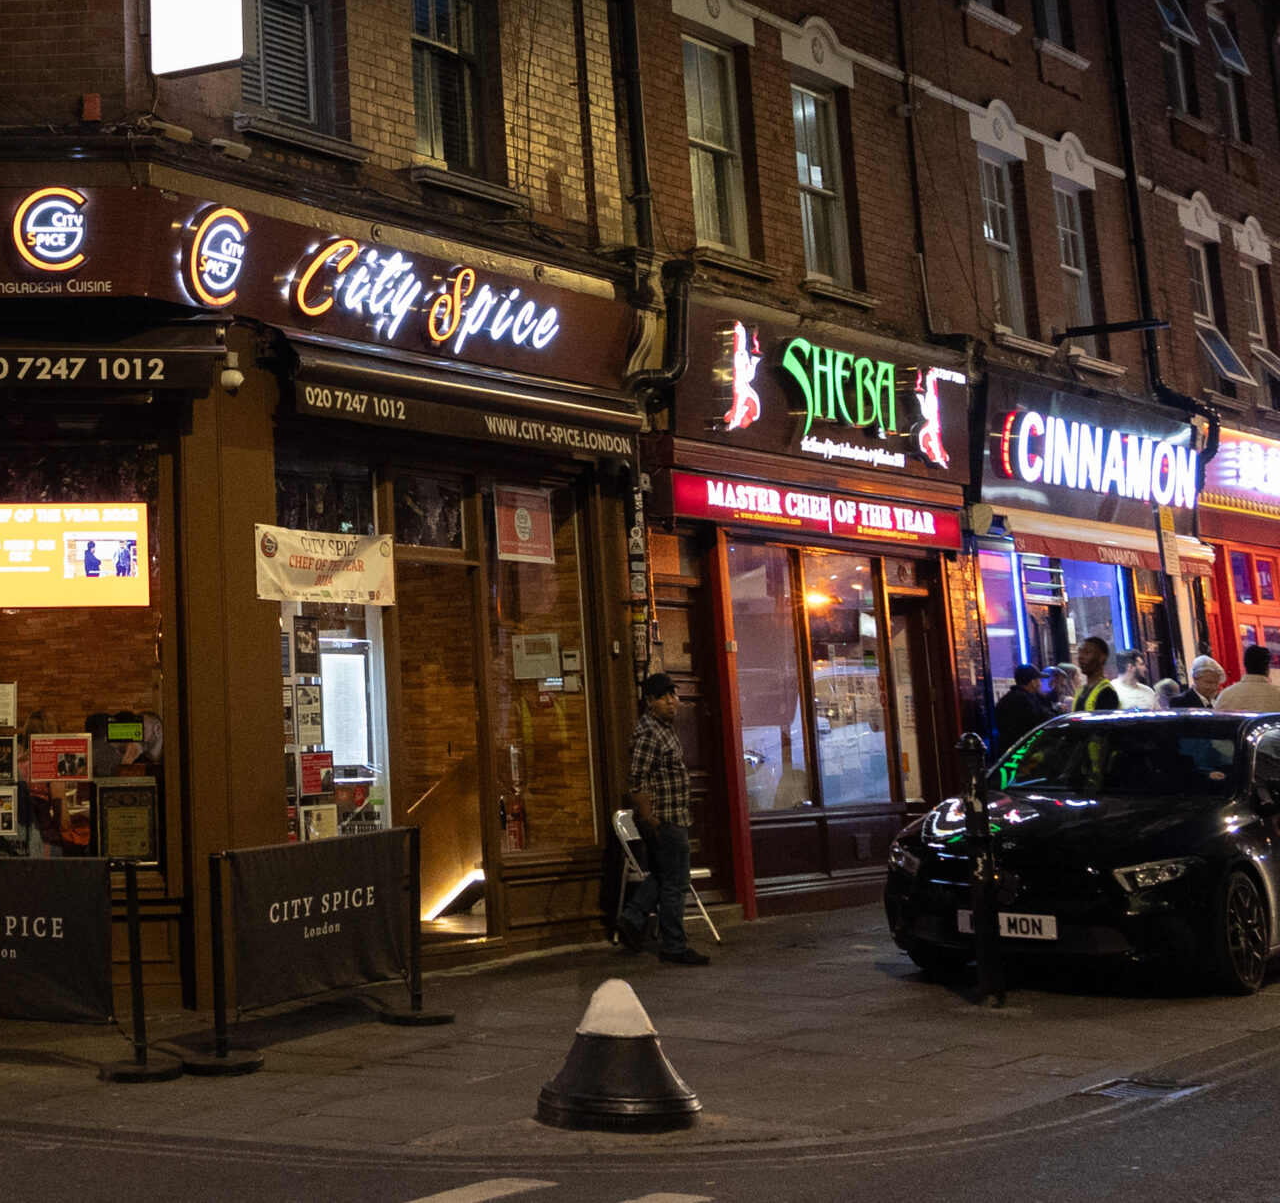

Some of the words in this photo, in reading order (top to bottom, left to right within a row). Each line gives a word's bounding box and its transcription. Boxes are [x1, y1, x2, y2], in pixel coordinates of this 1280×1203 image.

[27, 231, 66, 247] SPICE
[199, 255, 229, 278] SPICE
[297, 239, 422, 340] City
[428, 268, 560, 355] Spice
[17, 357, 87, 380] 7247
[98, 358, 164, 380] 1012
[782, 337, 897, 437] SHEBA
[305, 385, 332, 409] 020
[334, 389, 369, 414] 7247
[373, 396, 406, 421] 1012
[484, 414, 632, 455] WWW.CITY-SPICE.LONDON
[1018, 411, 1198, 509] CINNAMON
[14, 508, 34, 523] OF
[36, 508, 62, 523] THE
[63, 508, 100, 523] YEAR
[706, 480, 783, 516] MASTER
[784, 491, 830, 522] CHEF
[834, 498, 857, 525] OF
[858, 502, 893, 530] THE
[893, 507, 936, 535] YEAR
[300, 536, 325, 555] CITY
[1098, 546, 1140, 566] CINNAMON
[289, 555, 314, 571] CHEF
[315, 558, 328, 572] OF
[269, 896, 314, 924] CITY
[321, 885, 375, 915] SPICE
[303, 921, 341, 939] London
[1007, 916, 1043, 936] MON
